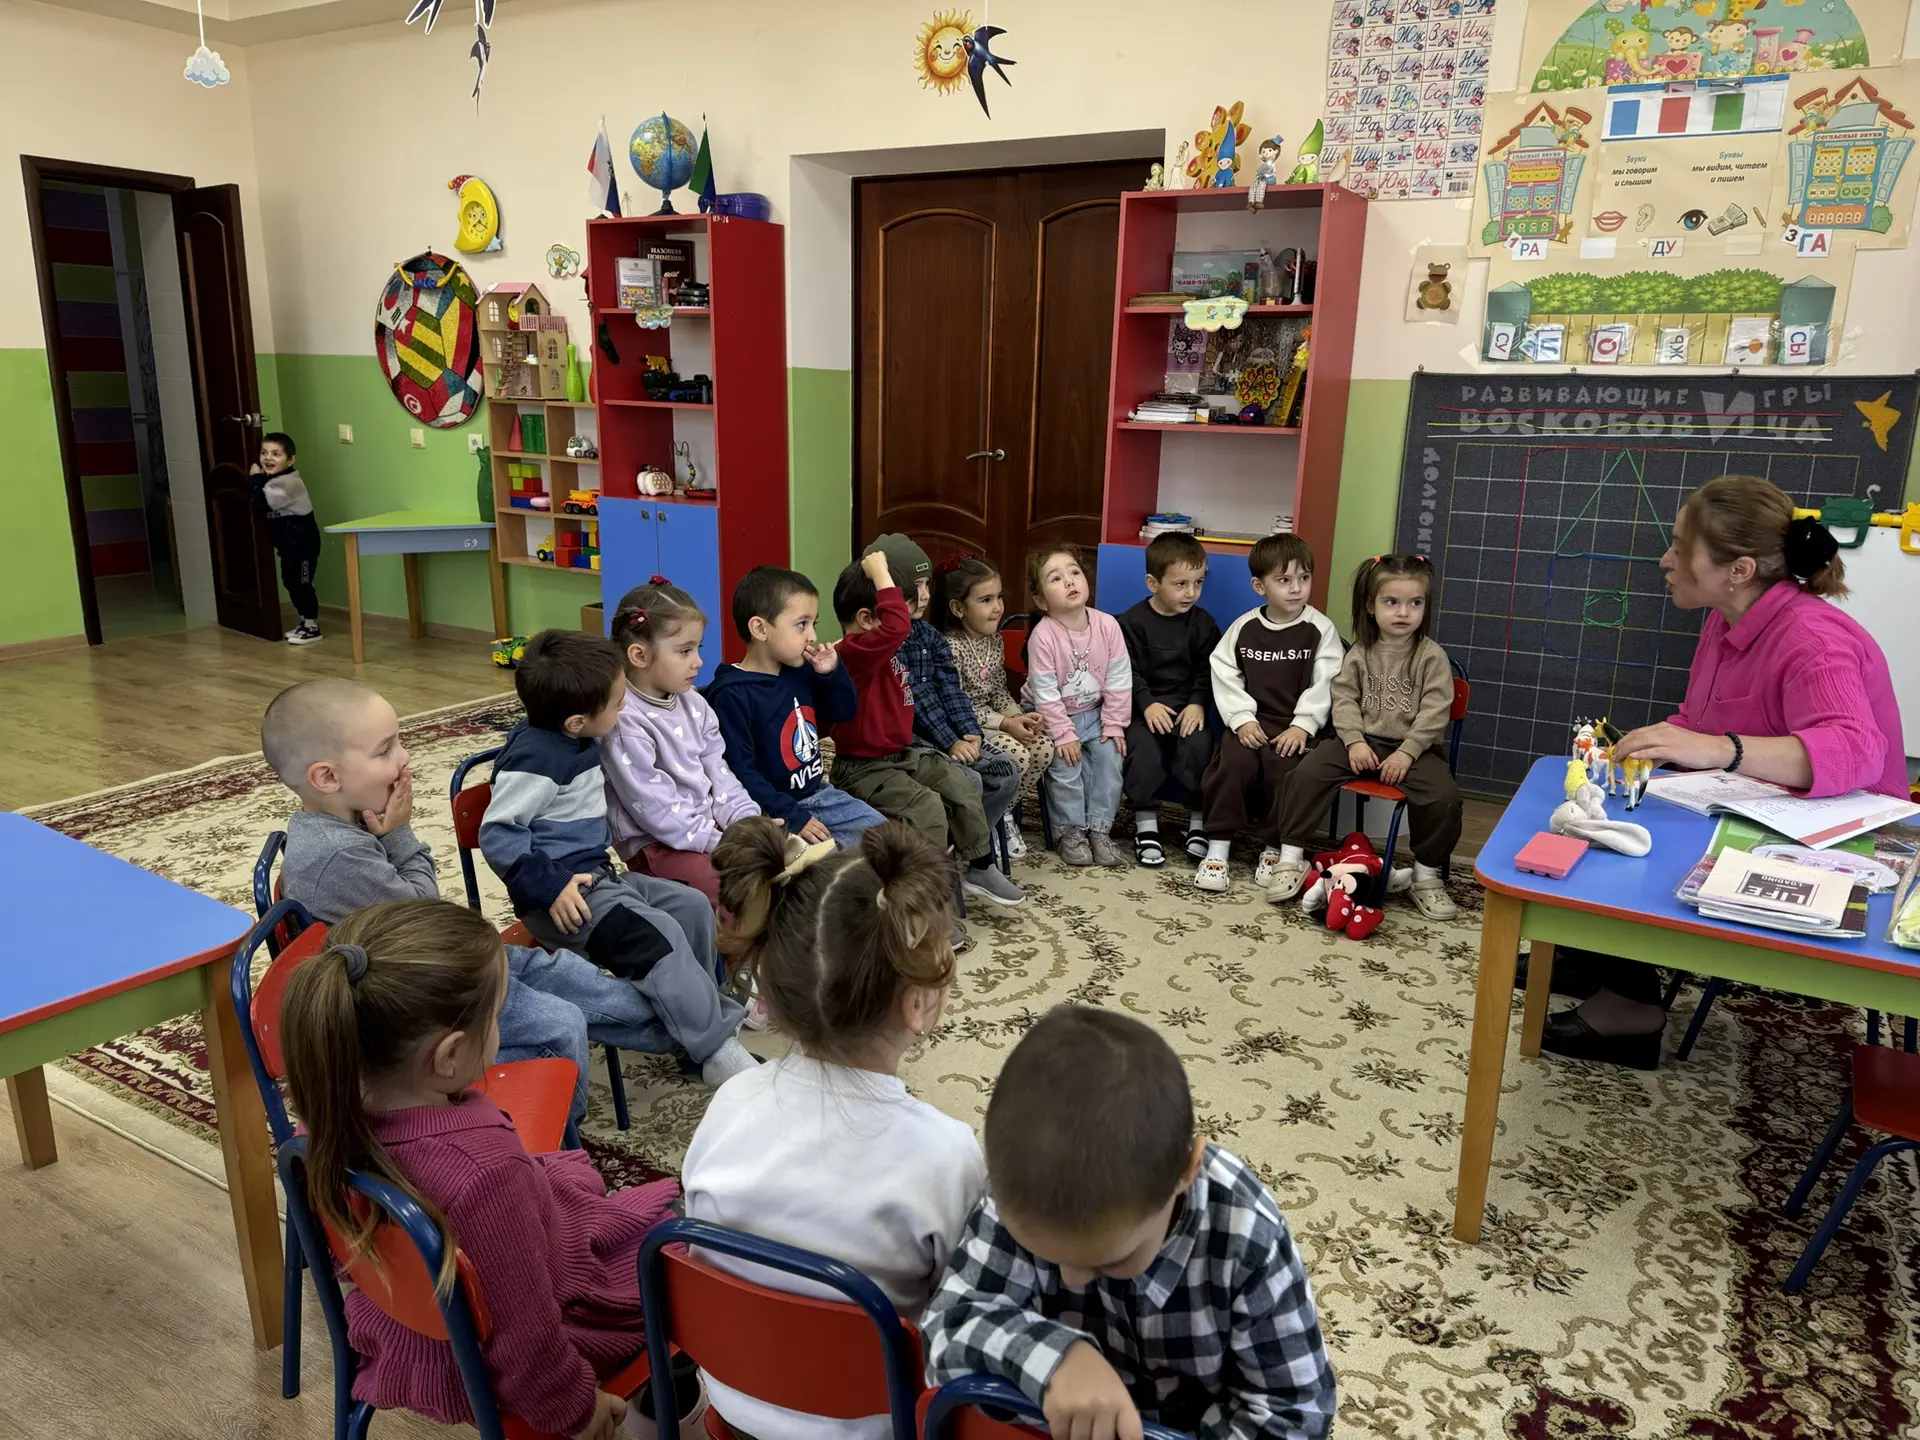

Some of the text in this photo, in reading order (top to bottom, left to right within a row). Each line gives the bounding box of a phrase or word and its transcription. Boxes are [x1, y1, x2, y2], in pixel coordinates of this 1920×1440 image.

[1626, 155, 1647, 164] Звуки
[1719, 151, 1743, 160] Буквы
[1612, 166, 1658, 176] мы говорим
[1692, 161, 1768, 173] мы видим, читаем
[1620, 178, 1652, 187] слышим
[1716, 175, 1745, 183] пишем
[1784, 227, 1798, 243] 3
[1652, 240, 1677, 257] ДУ
[1798, 233, 1827, 252] ГА
[1520, 243, 1540, 257] РА
[1461, 385, 1689, 409] РАЗВИВАЮЩИЕ
[1761, 875, 1803, 887] LOADING
[1745, 885, 1806, 905] LIFE
